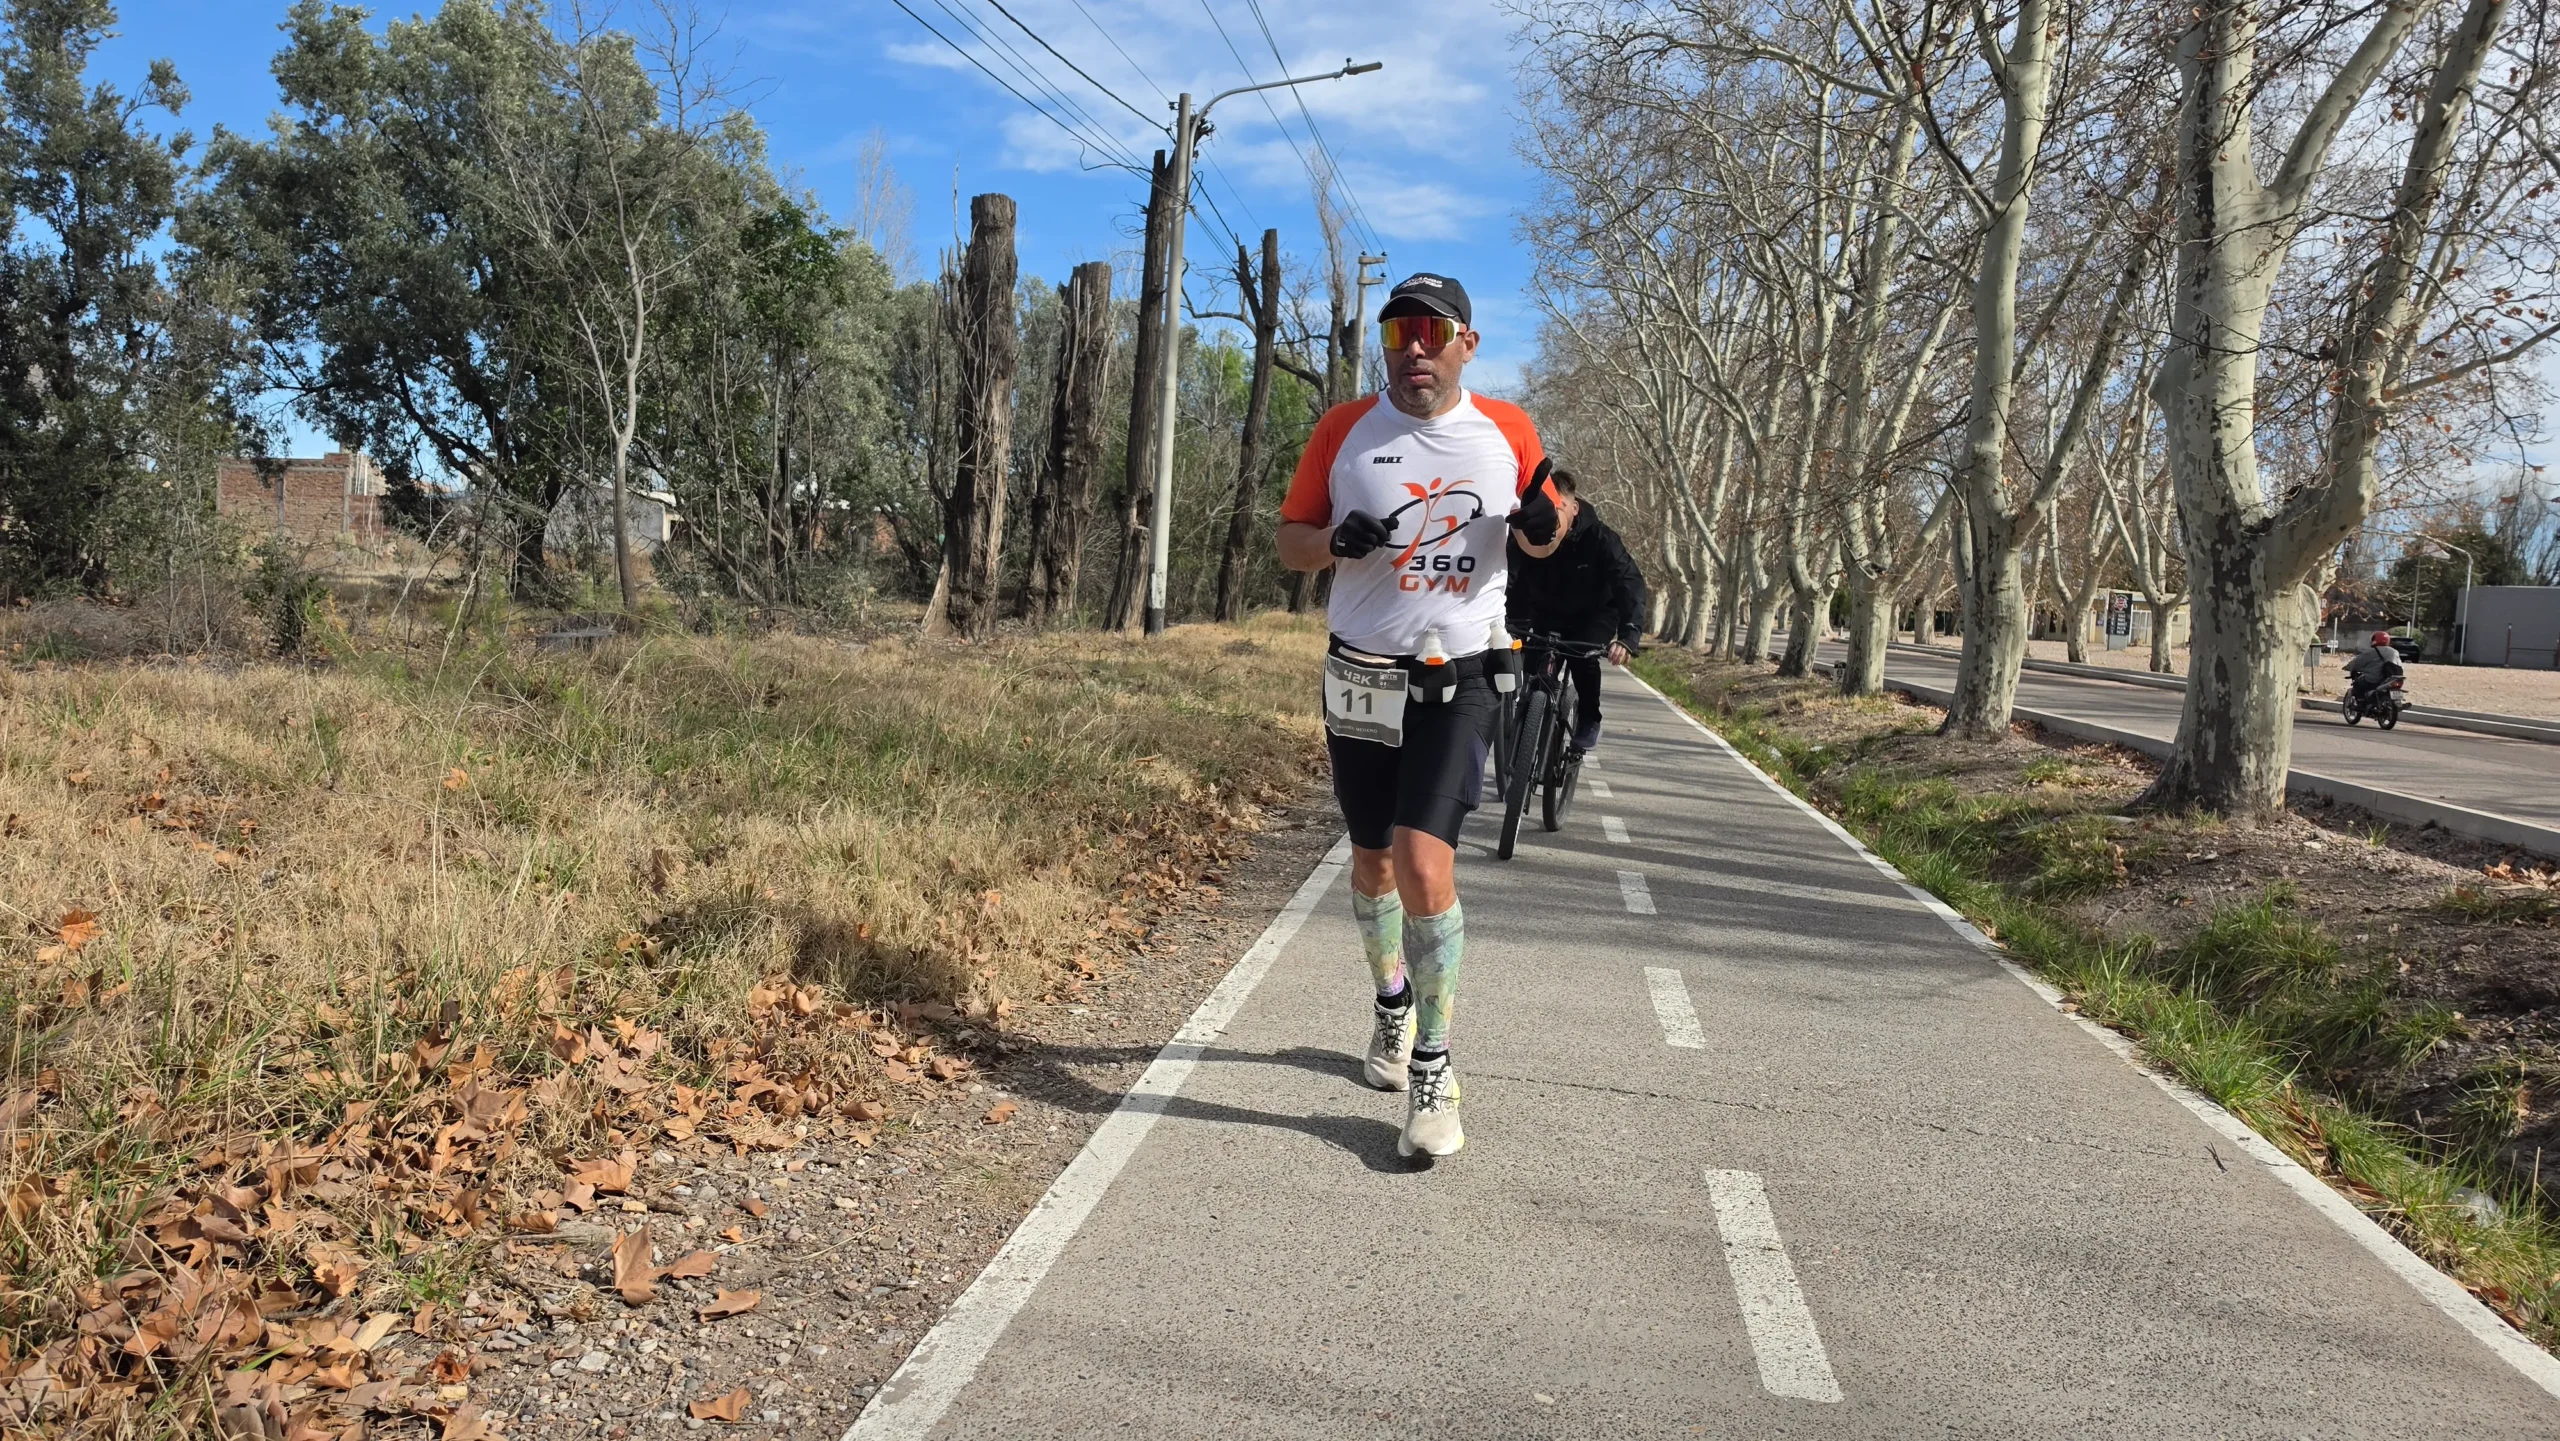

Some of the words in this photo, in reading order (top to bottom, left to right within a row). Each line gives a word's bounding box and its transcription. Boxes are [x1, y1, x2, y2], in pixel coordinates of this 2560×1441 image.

[1409, 555, 1476, 573] 360
[1400, 574, 1471, 593] GYM
[1343, 669, 1373, 686] 42K
[1341, 688, 1372, 715] 11
